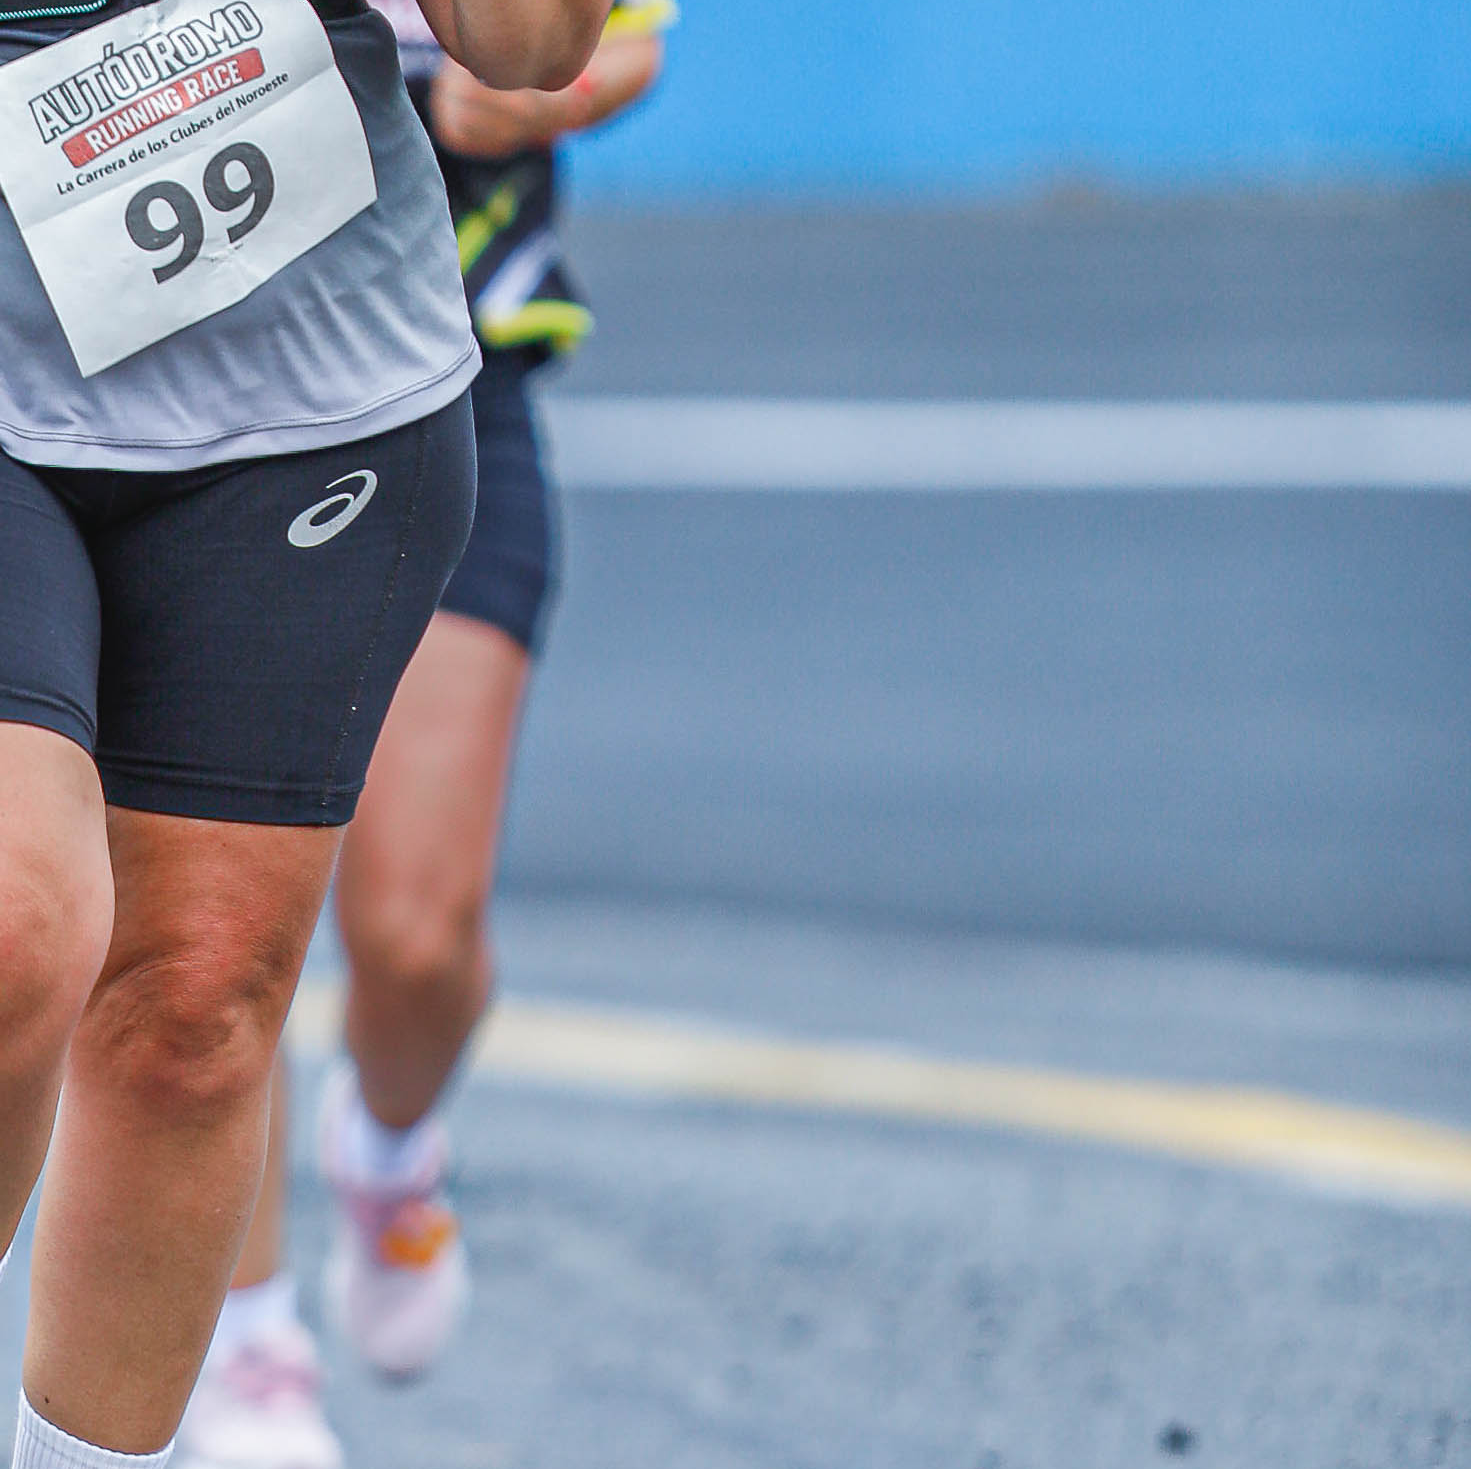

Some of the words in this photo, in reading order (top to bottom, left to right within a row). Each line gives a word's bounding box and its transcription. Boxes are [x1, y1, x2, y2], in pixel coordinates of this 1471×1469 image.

[29, 1, 263, 143] AUTÓDROMO
[57, 181, 75, 196] La
[76, 159, 126, 187] Carrera
[128, 147, 146, 164] de
[149, 135, 169, 155] los
[170, 117, 214, 145] Clubes
[216, 101, 236, 122] del
[237, 71, 289, 111] Noroeste
[85, 88, 184, 155] RUNNING
[183, 59, 244, 103] RACE
[125, 141, 275, 285] 99
